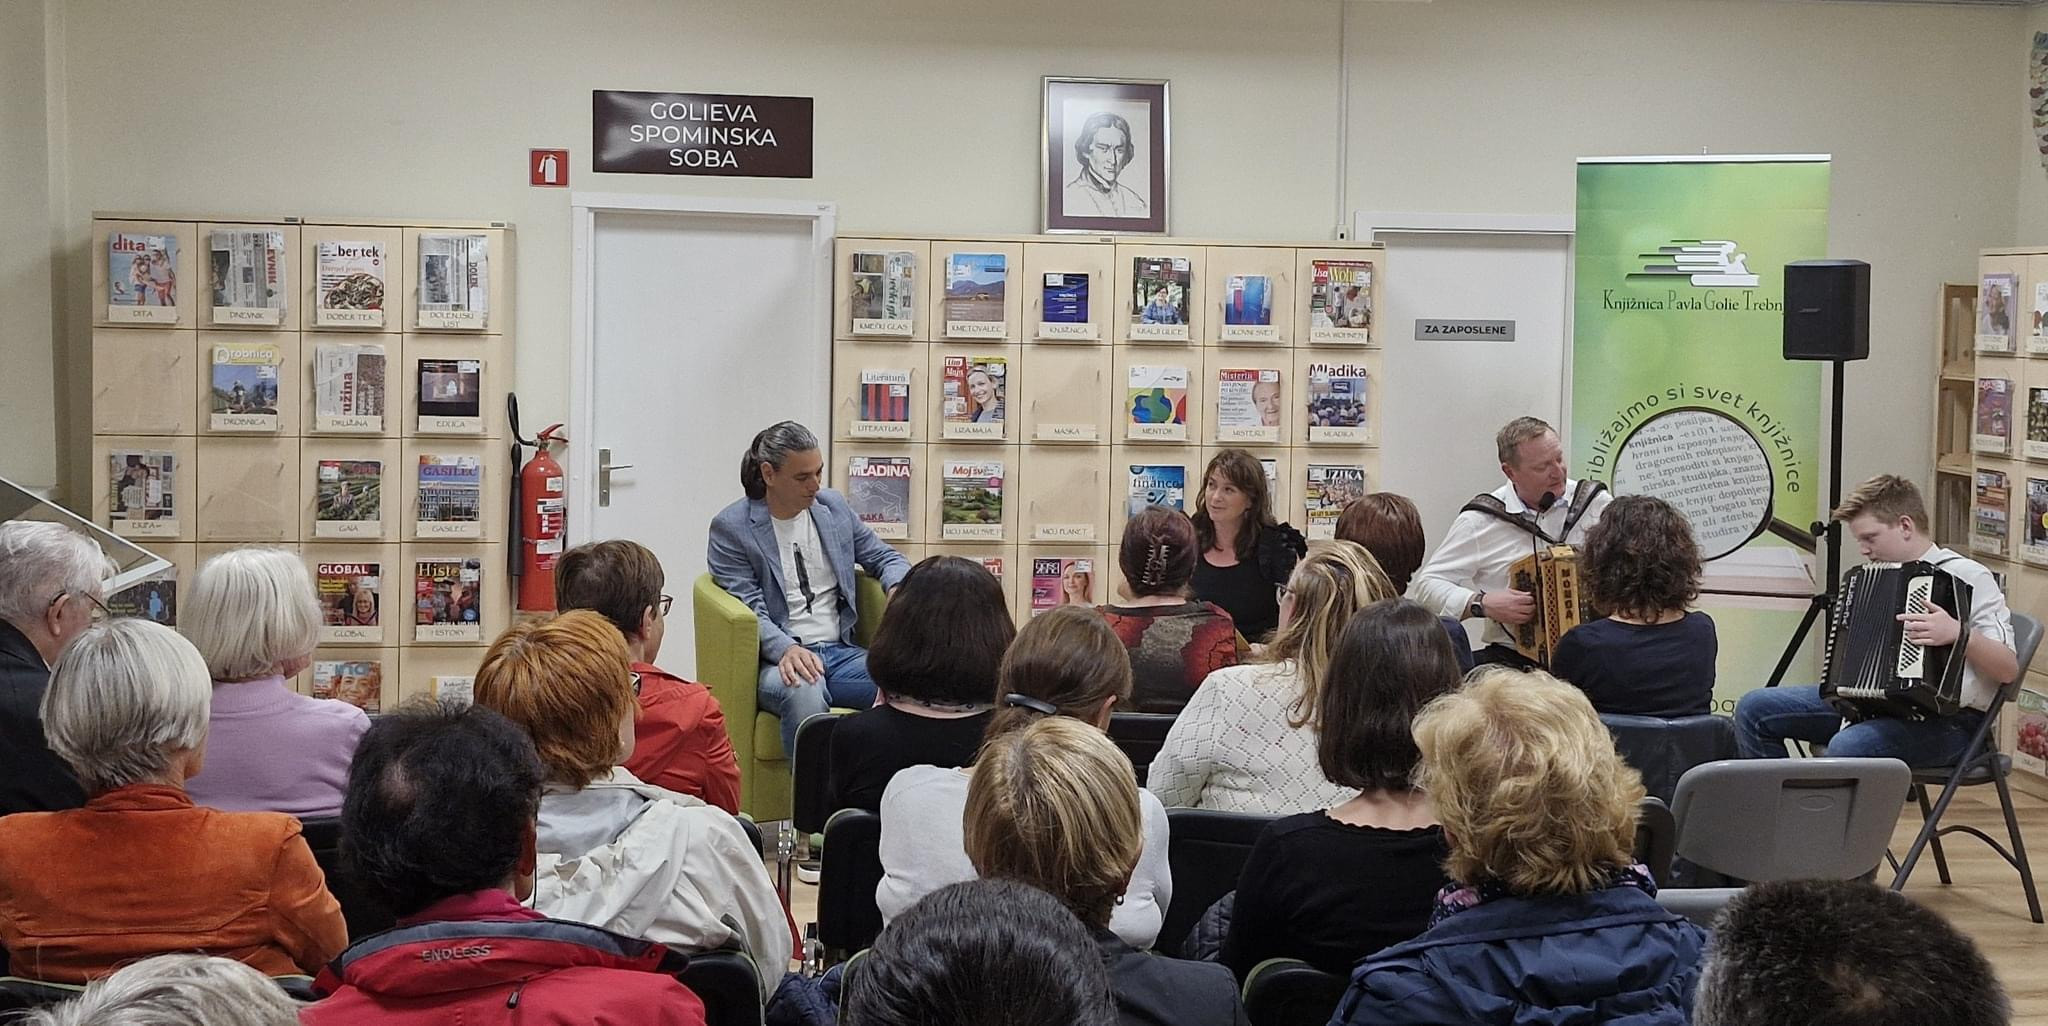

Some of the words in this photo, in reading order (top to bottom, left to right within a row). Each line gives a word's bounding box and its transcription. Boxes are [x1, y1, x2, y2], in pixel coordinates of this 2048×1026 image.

[650, 102, 758, 123] GOLIEVA
[629, 124, 778, 147] SPOMINSKA
[669, 149, 739, 168] SOBA
[112, 233, 146, 252] dita
[334, 245, 357, 258] ber
[361, 246, 380, 258] tek
[1602, 289, 1664, 313] Knjižnica
[1667, 289, 1702, 311] Pavla
[1703, 289, 1740, 312] Golie
[326, 313, 356, 321] DOBER
[358, 313, 374, 321] TEK
[442, 320, 461, 328] LIST
[887, 323, 909, 331] GLAS
[951, 324, 1002, 333] KMETOVALEC
[1424, 324, 1440, 334] ZA
[1441, 325, 1508, 335] ZAPOSLENE
[1049, 325, 1089, 335] KNJIŽNICA
[1309, 363, 1367, 378] Mladika
[866, 372, 907, 384] Literatura
[339, 372, 353, 415] užina
[223, 417, 267, 426] DROBNICA
[857, 425, 905, 433] LITERATURA
[1053, 427, 1081, 436] MASKA
[1142, 427, 1173, 436] MENTOR
[1323, 430, 1355, 438] MLADIKA
[1628, 433, 1674, 449] knjižnica
[1666, 383, 1685, 401] si
[1693, 385, 1741, 409] svet
[1746, 401, 1803, 493] knjižnice
[423, 466, 478, 477] GASILEC
[849, 464, 910, 478] MLADINA
[952, 466, 972, 478] Moj
[1711, 500, 1747, 513] bogato
[431, 525, 466, 533] GASILEC
[1042, 528, 1058, 536] MOJ
[1059, 528, 1088, 536] PLANET
[319, 564, 369, 576] GLOBAL
[333, 630, 367, 638] GLOBAL
[431, 629, 466, 638] HISTORY
[421, 944, 492, 962] ENDLESS
